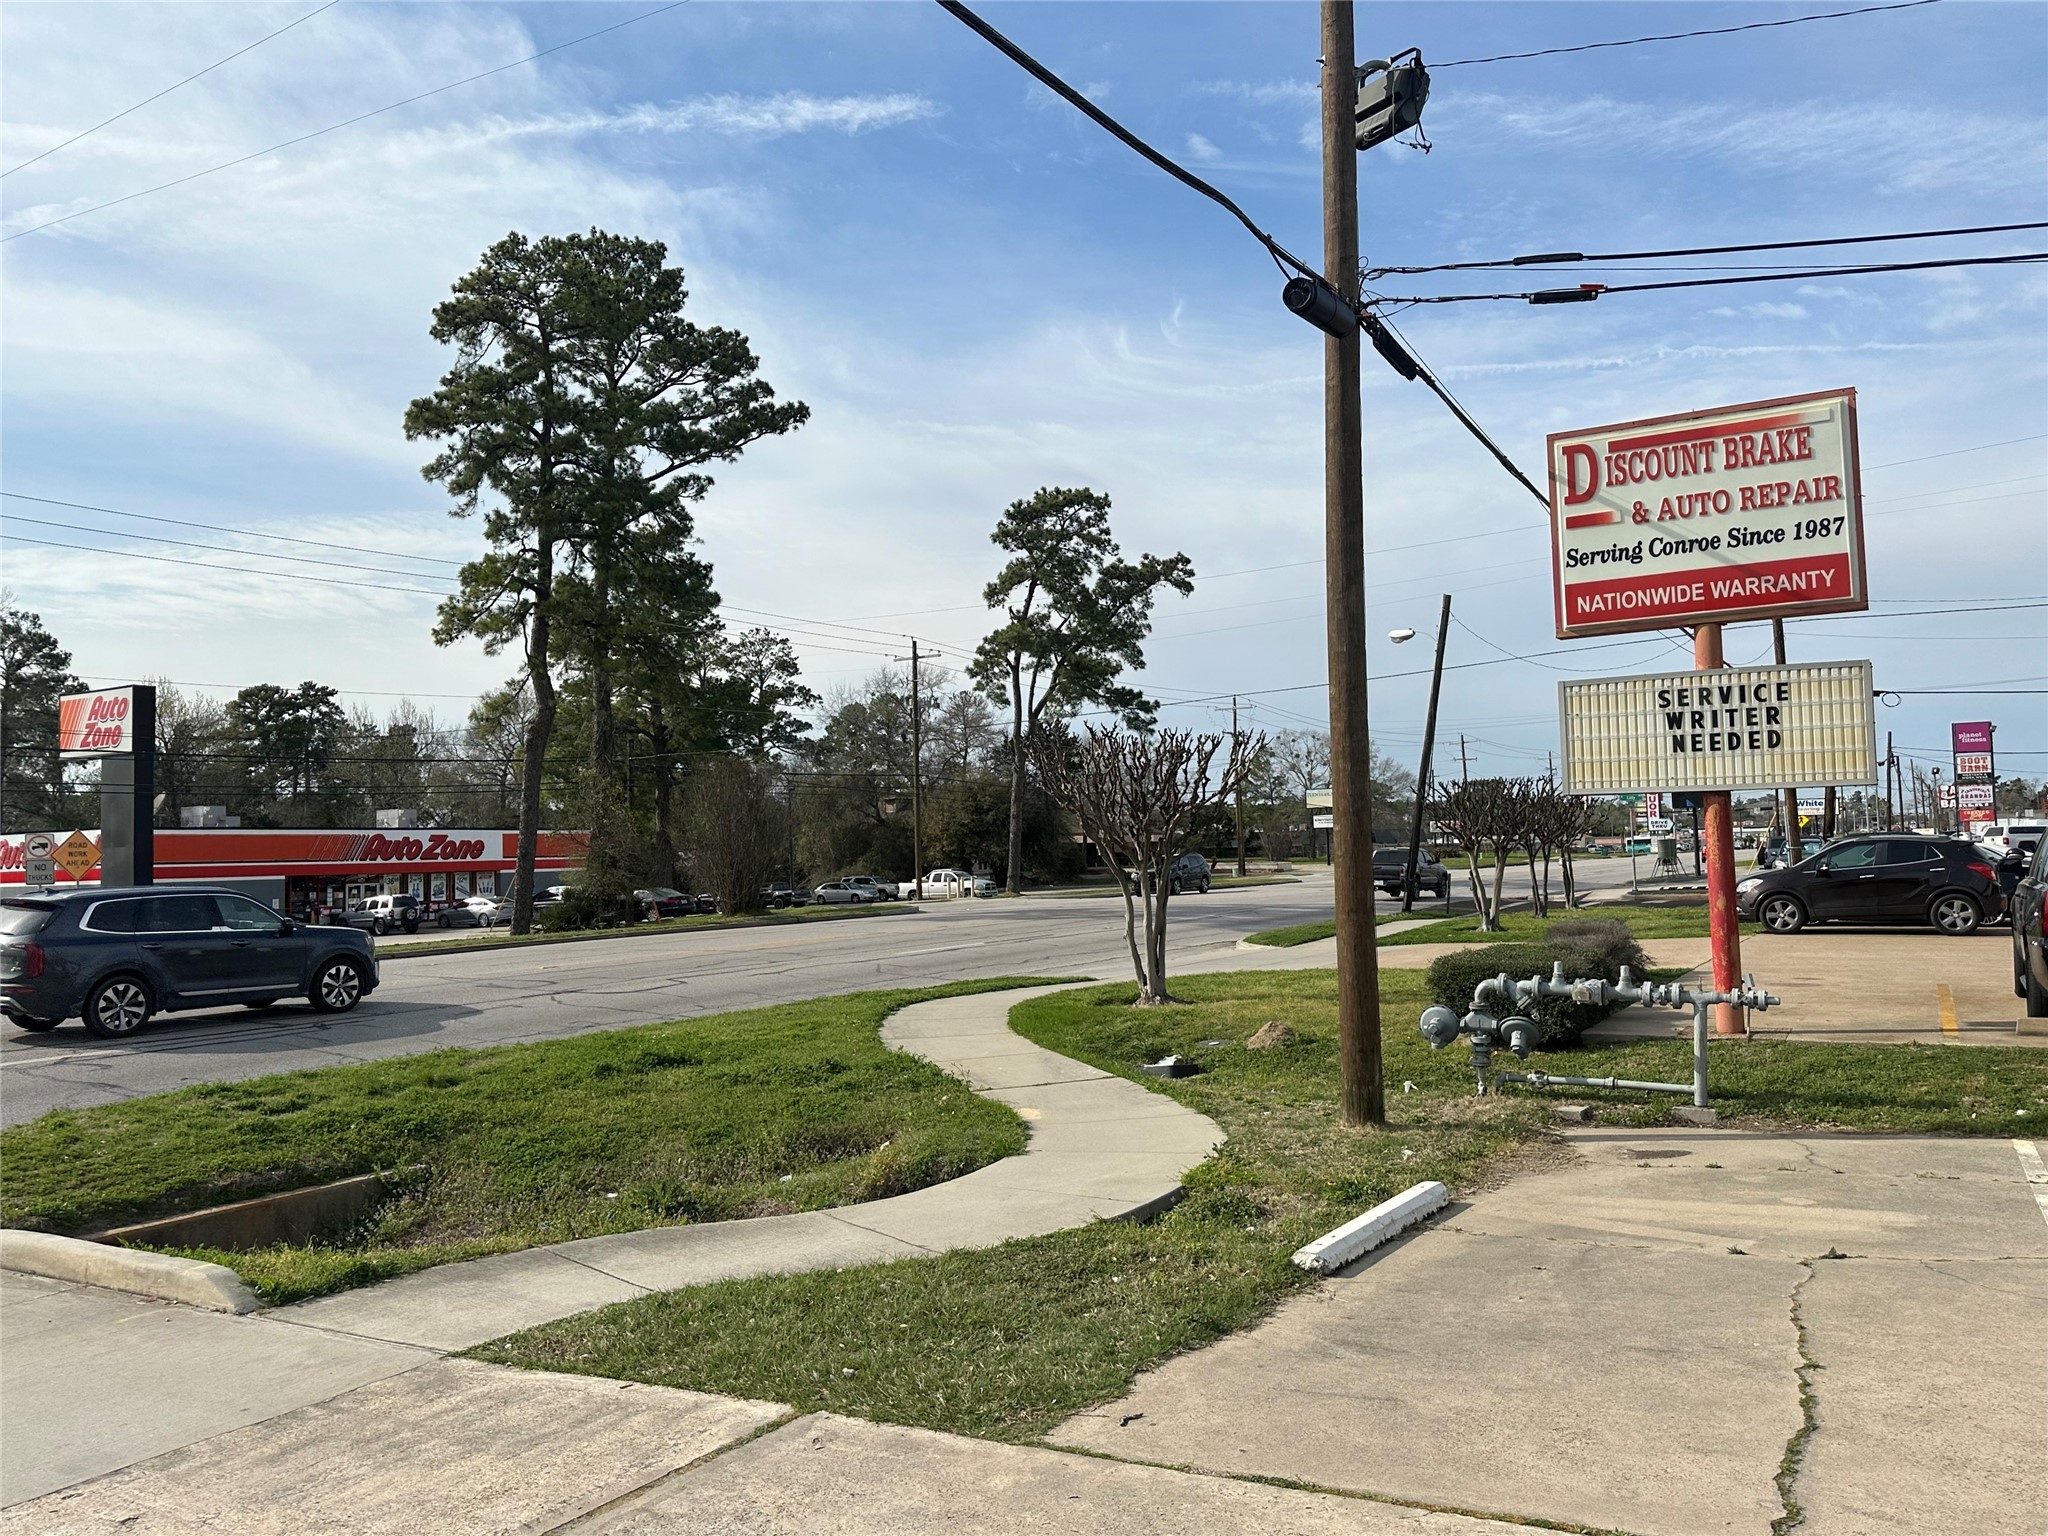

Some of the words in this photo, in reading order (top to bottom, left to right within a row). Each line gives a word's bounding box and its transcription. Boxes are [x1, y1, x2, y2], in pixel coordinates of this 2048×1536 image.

[1562, 441, 1715, 505] DISCOUNT
[1723, 426, 1813, 470] BRAKE
[1631, 500, 1650, 525] &
[1657, 489, 1731, 521] AUTO
[1738, 475, 1842, 511] REPAIR
[1566, 540, 1643, 568] Serving
[1648, 534, 1721, 558] Conroe
[1727, 526, 1785, 548] Since
[1793, 516, 1845, 540] 1987
[1577, 583, 1704, 614] NATIONWIDE
[1710, 568, 1836, 598] WARRANTY
[87, 695, 129, 723] Auto
[1657, 682, 1789, 708] SERVICE
[1666, 706, 1781, 730] WRITER
[80, 722, 123, 750] Zone
[1672, 729, 1782, 753] NEEDED
[1958, 732, 1982, 740] planet
[1959, 756, 1988, 765] BOOT
[1960, 764, 1989, 773] BARN
[360, 833, 485, 861] AutoZone
